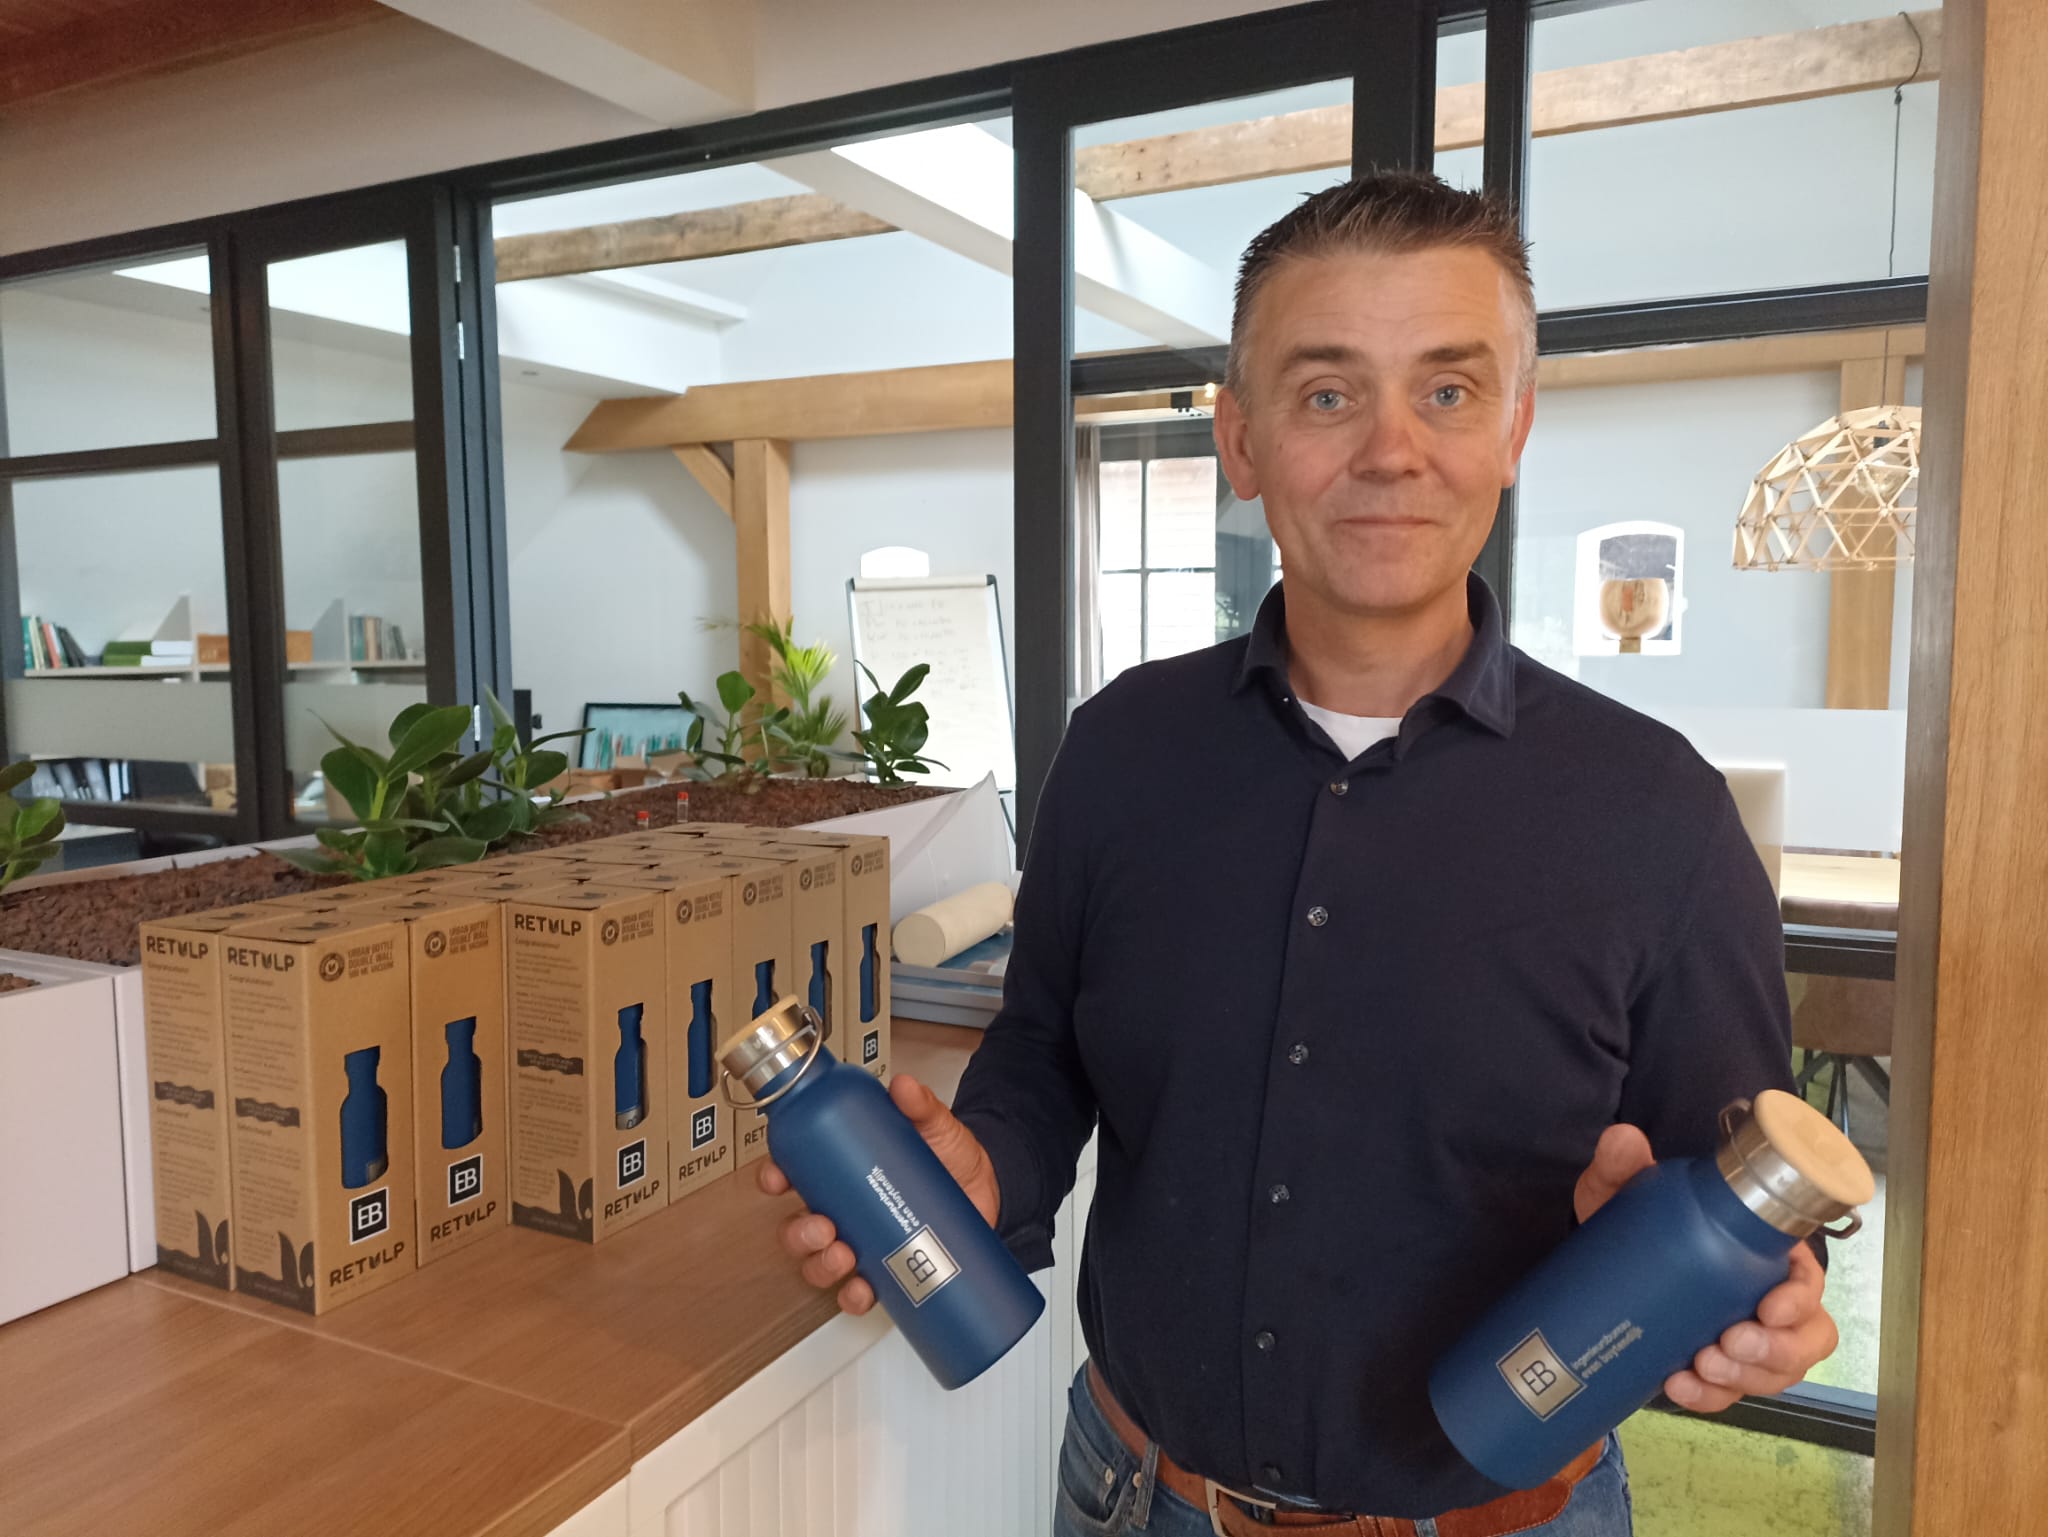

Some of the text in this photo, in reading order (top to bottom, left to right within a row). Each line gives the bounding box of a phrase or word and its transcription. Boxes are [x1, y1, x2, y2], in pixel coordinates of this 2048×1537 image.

[513, 912, 582, 937] RETULP
[146, 935, 208, 960] RETULP
[227, 946, 295, 972] RETULP
[744, 1125, 766, 1147] RET
[678, 1145, 727, 1181] RETULP
[604, 1180, 660, 1220] RETULP
[430, 1201, 497, 1242] RETULP
[329, 1241, 405, 1287] RETULP
